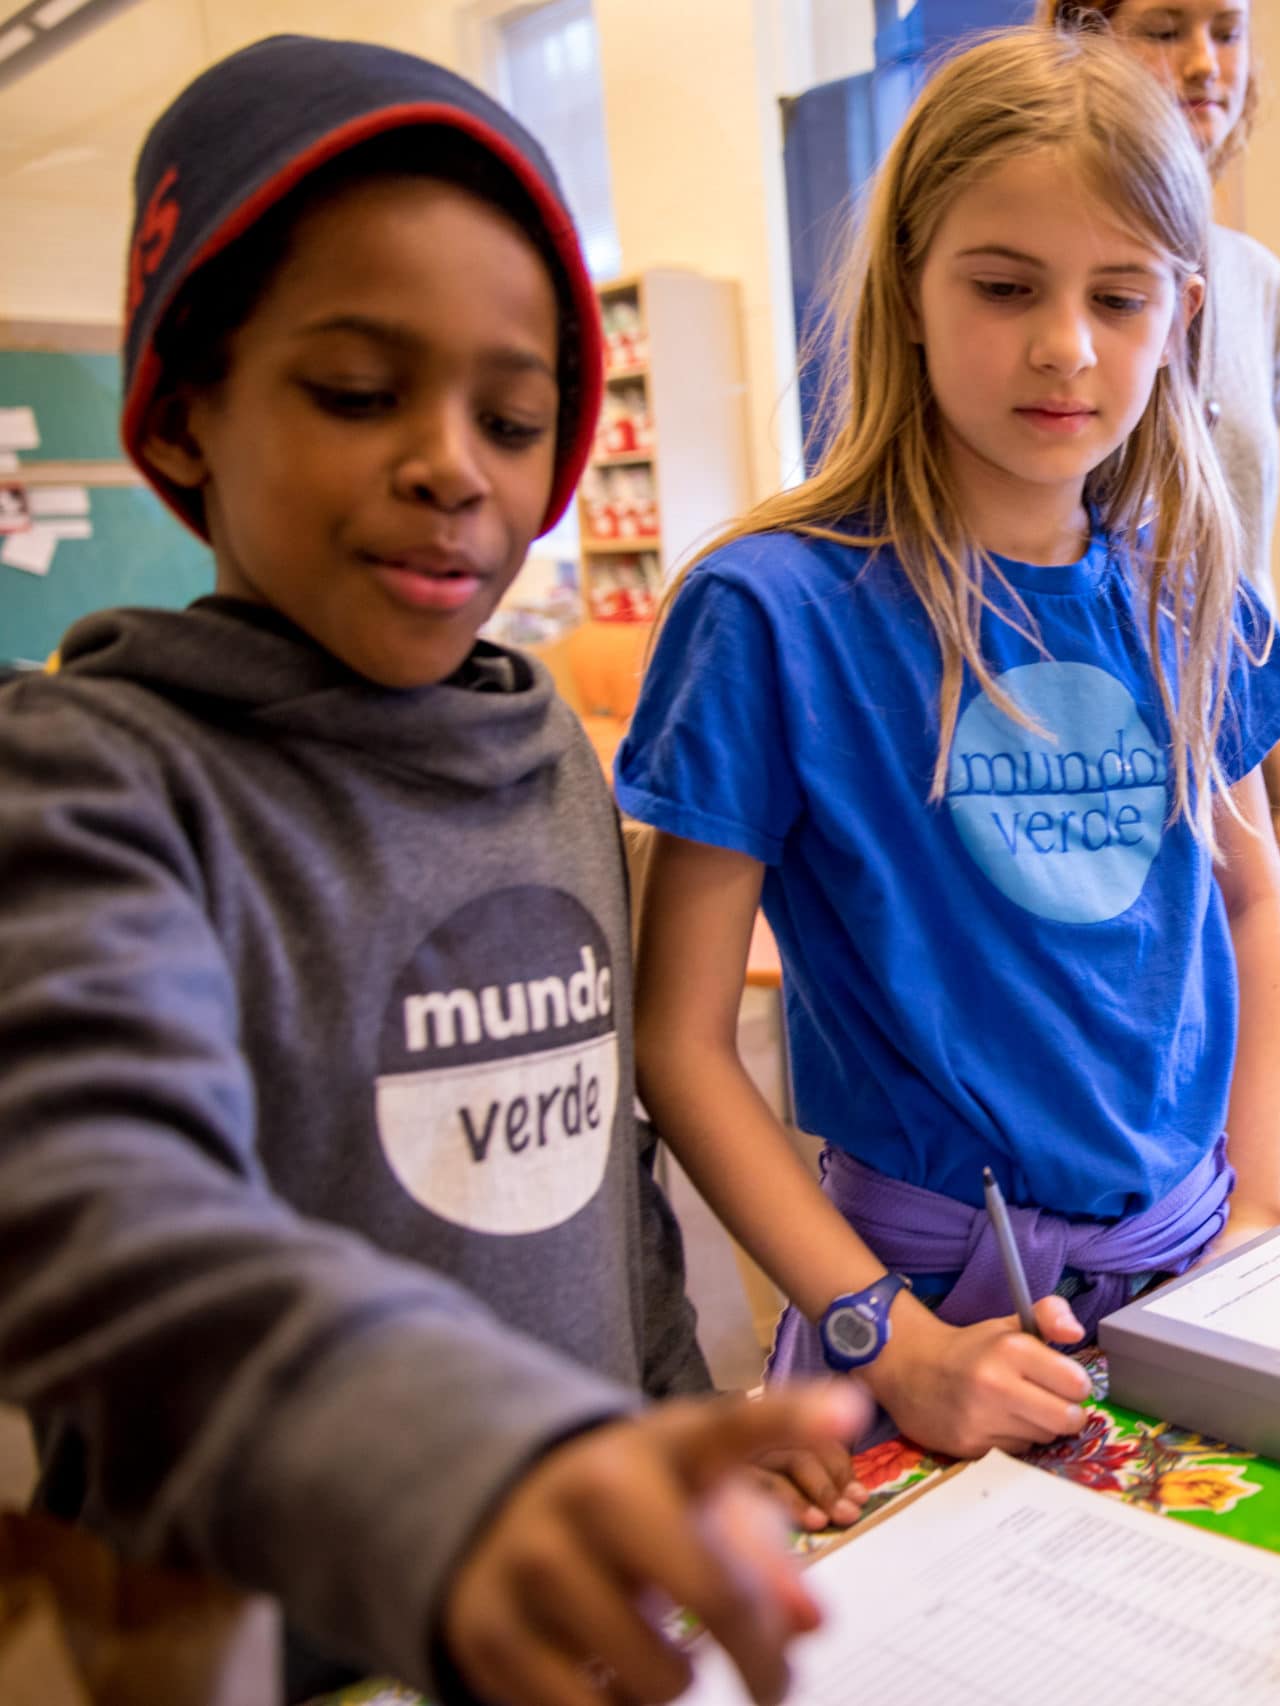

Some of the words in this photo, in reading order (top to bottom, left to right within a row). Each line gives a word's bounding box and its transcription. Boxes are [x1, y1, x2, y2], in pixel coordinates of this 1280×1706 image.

[959, 729, 1160, 795] mundo
[991, 793, 1144, 855] verde
[459, 1060, 602, 1164] verde
